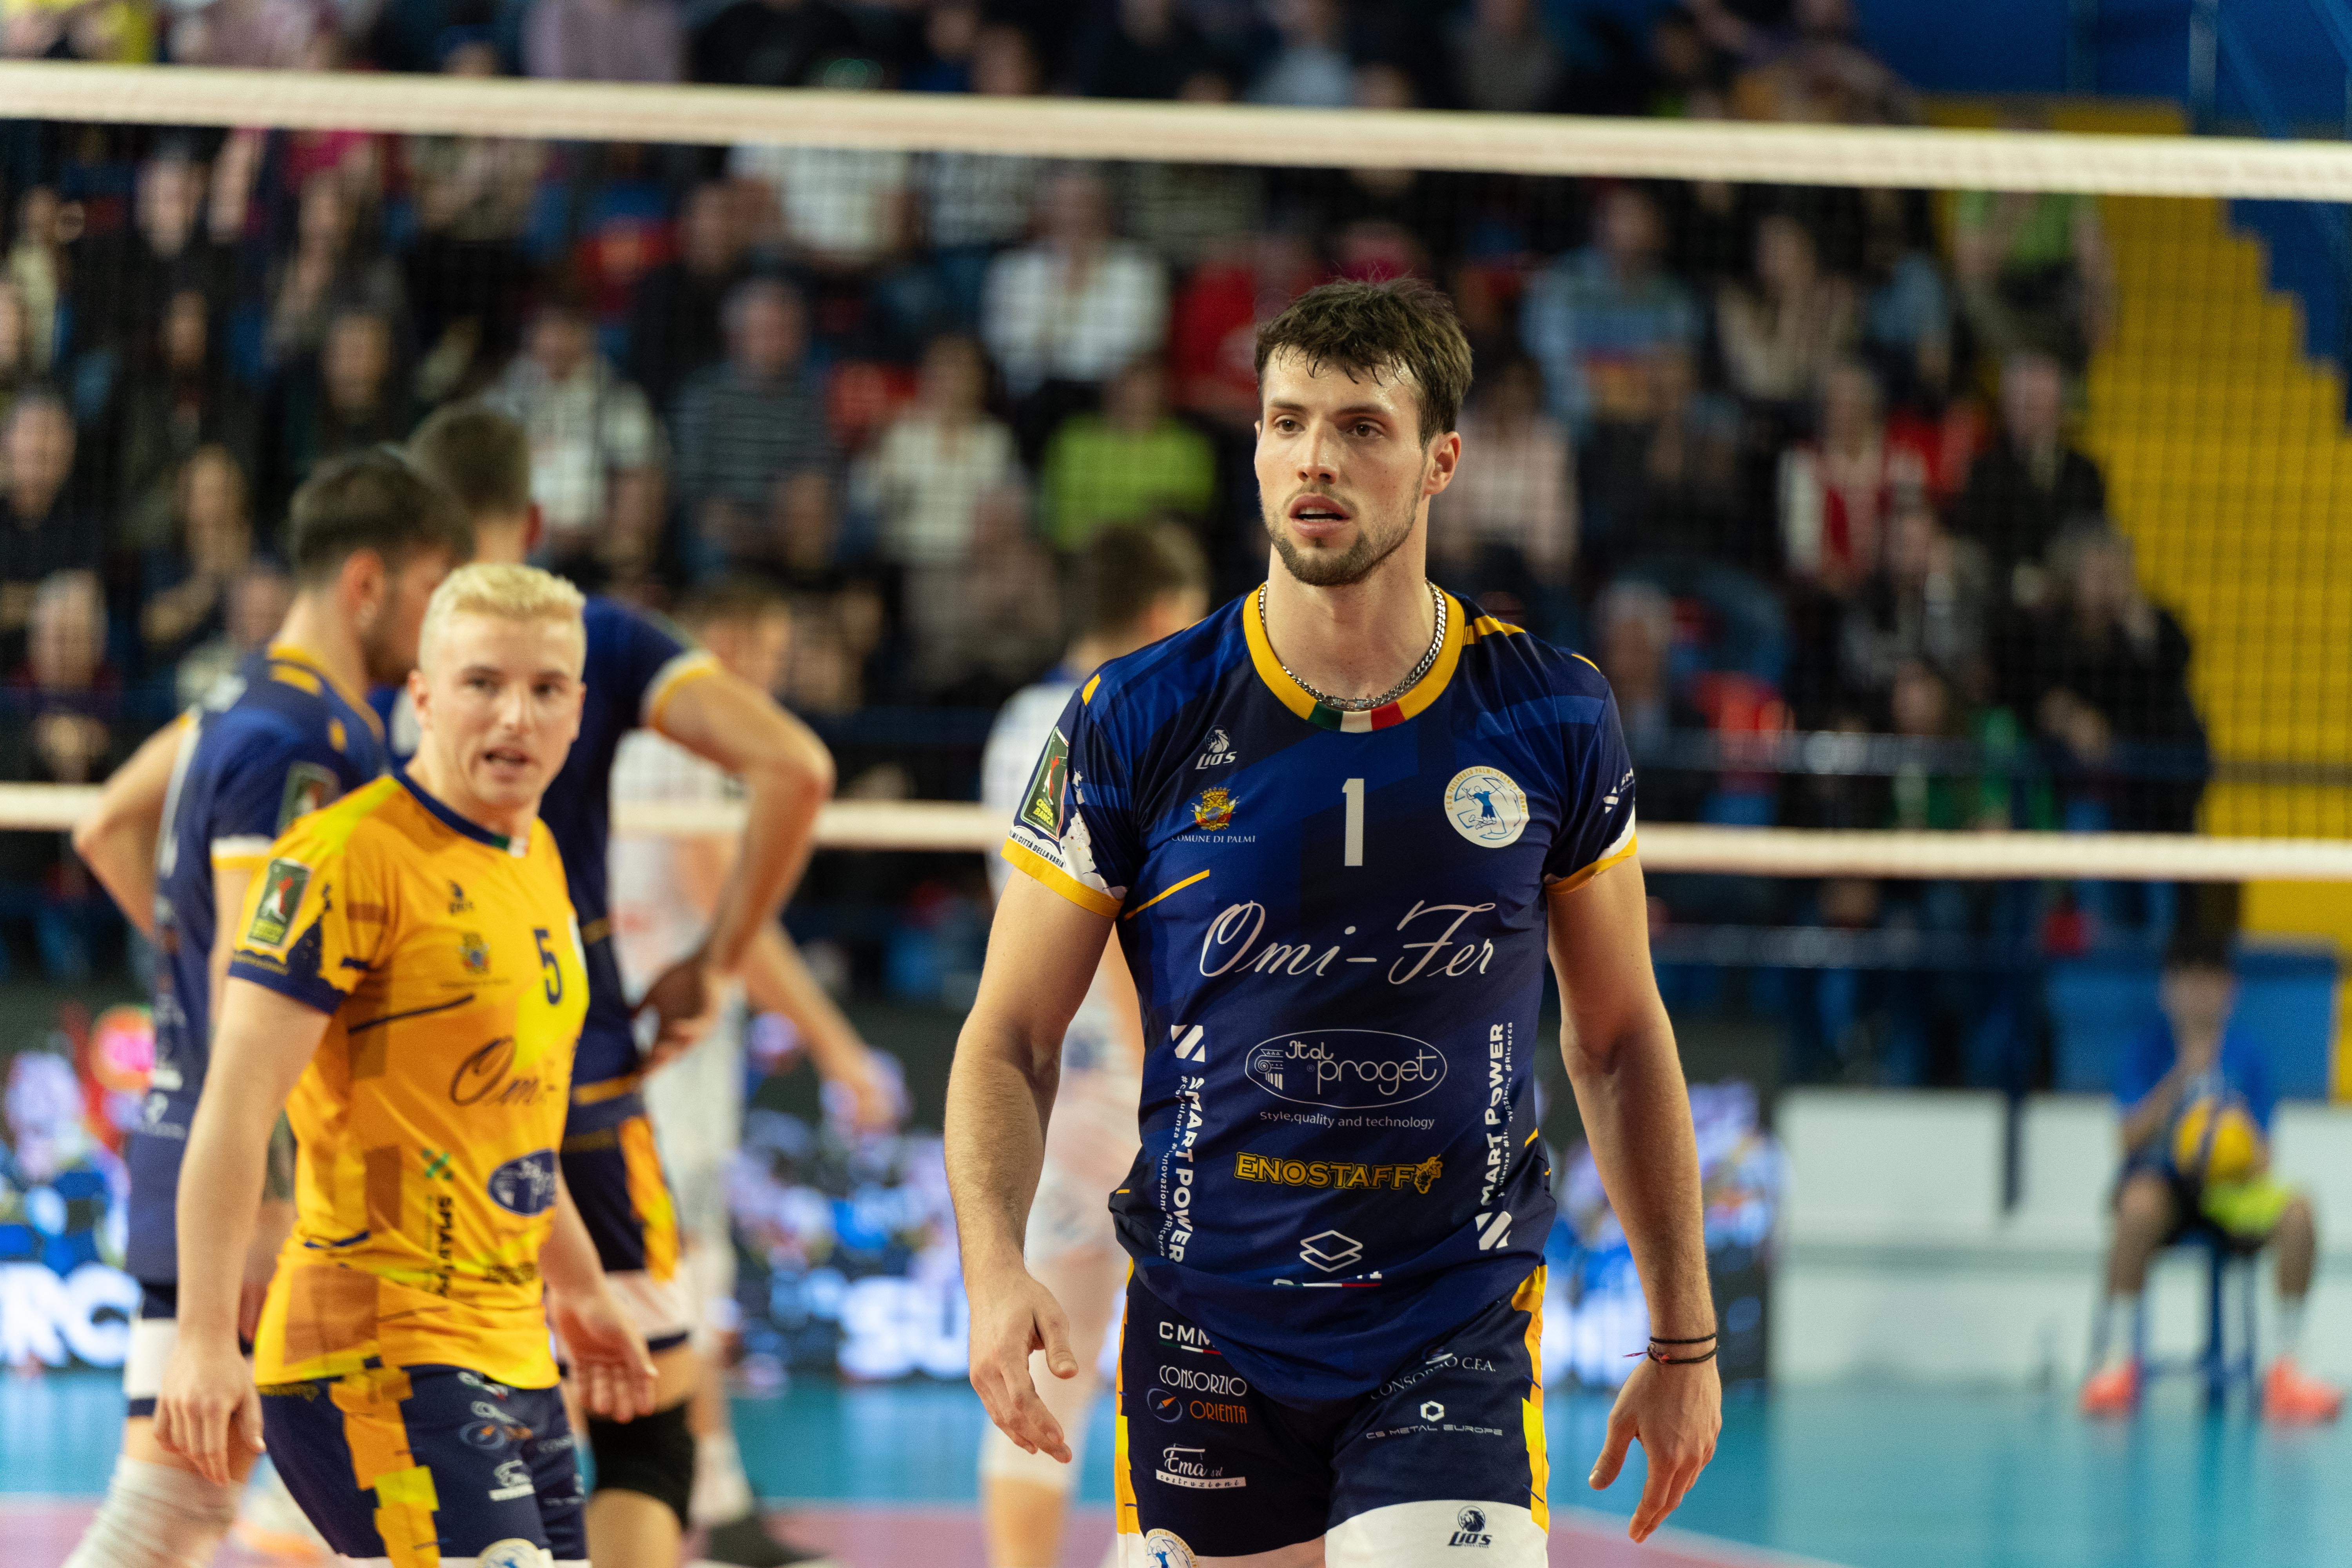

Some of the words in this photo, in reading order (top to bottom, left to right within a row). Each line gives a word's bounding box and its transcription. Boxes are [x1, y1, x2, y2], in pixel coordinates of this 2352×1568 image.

[1448, 769, 1474, 793] PALLAVOLO
[1033, 807, 1053, 827] BANCA
[1342, 778, 1364, 866] 1
[1018, 835, 1033, 848] CITTÀ
[1033, 845, 1049, 858] DELLA
[1049, 854, 1064, 868] VARIA
[532, 927, 563, 1006] 5
[1485, 1024, 1504, 1125] POWER
[1175, 1076, 1205, 1162] SMART
[1338, 1116, 1362, 1127] and
[1366, 1116, 1435, 1130] technology
[1234, 1151, 1417, 1190] ENOSTAFF
[1480, 1133, 1503, 1206] MART
[1169, 1168, 1193, 1263] POWER
[1159, 1365, 1247, 1396] CONSORZIO
[1190, 1400, 1247, 1424] ORIENTA
[1389, 1425, 1438, 1436] METAL
[1443, 1424, 1503, 1436] EUROPE
[1160, 1474, 1239, 1488] costruzioni
